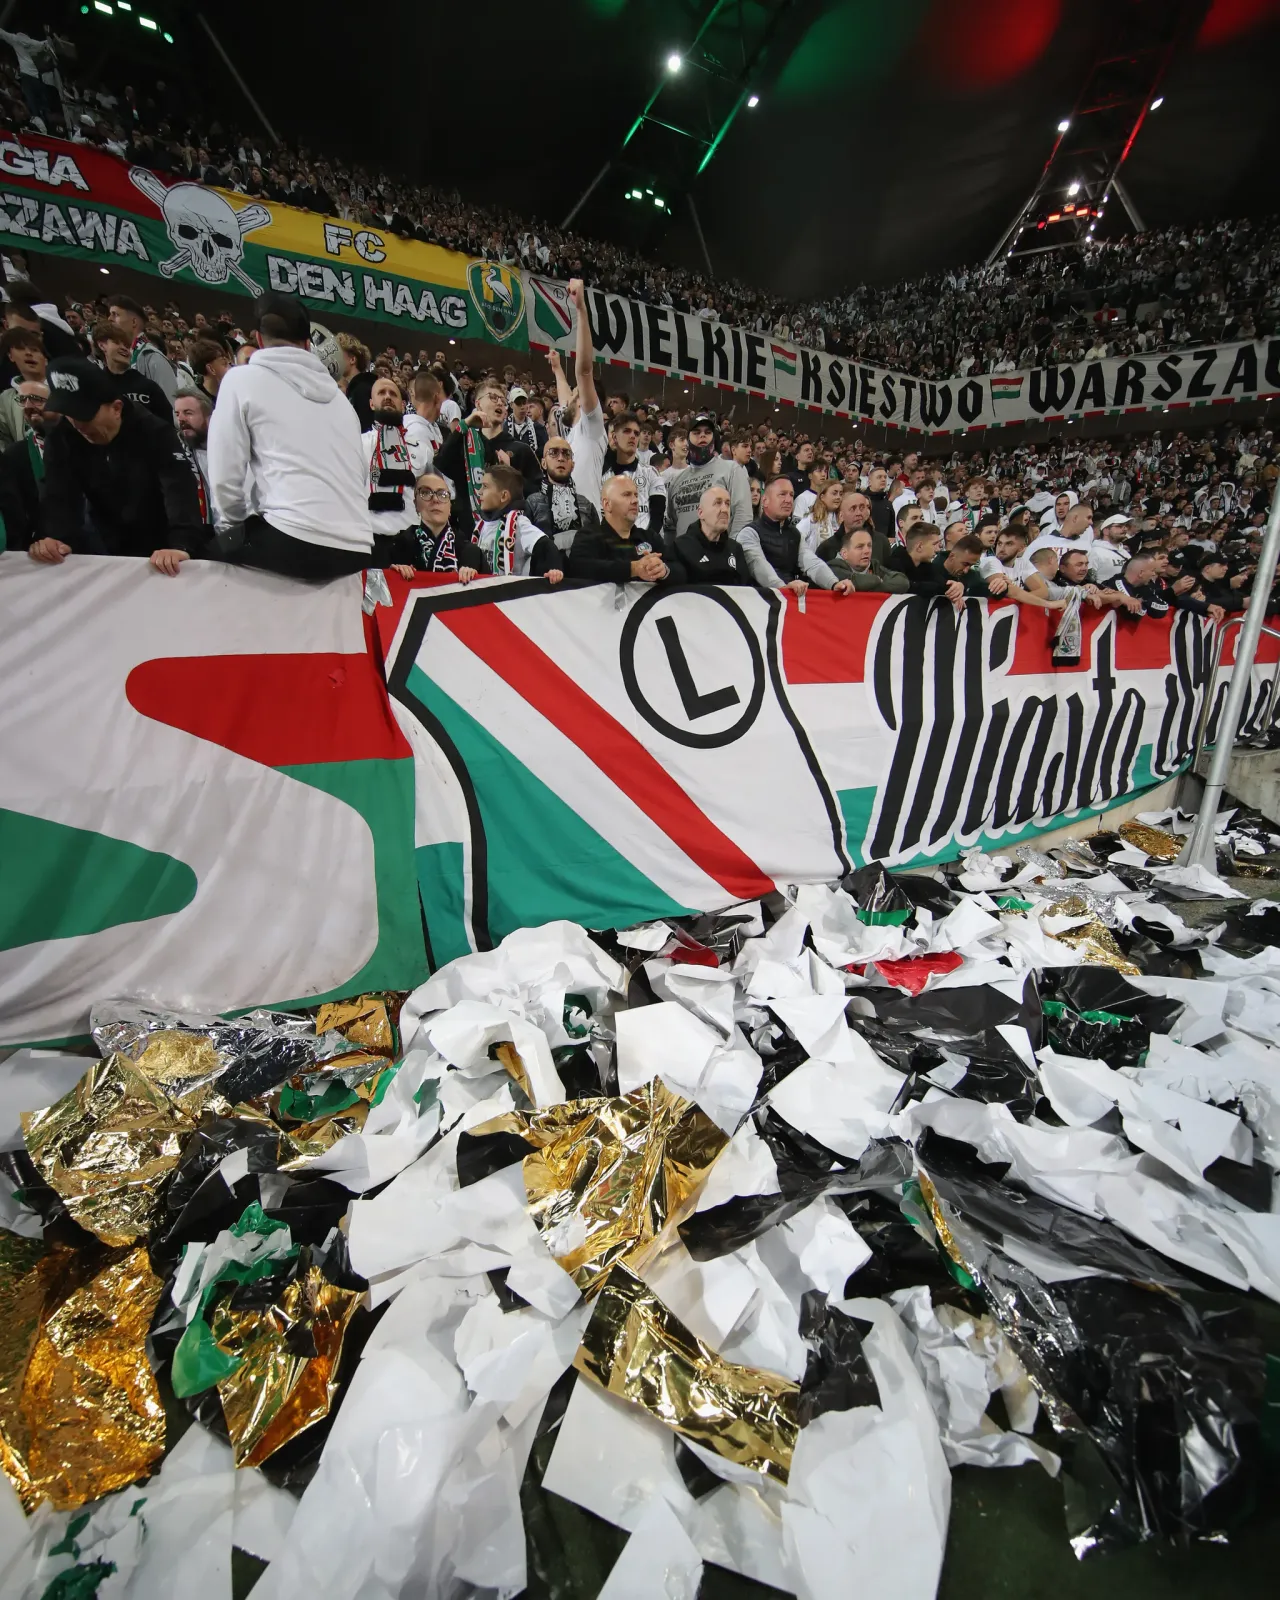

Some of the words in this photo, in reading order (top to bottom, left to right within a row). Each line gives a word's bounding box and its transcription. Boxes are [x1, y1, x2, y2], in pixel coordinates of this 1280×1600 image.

[323, 222, 388, 263] FC
[266, 254, 356, 307] DEN
[362, 273, 468, 328] HAAG
[583, 289, 767, 390] WIELKIE
[655, 615, 741, 721] L
